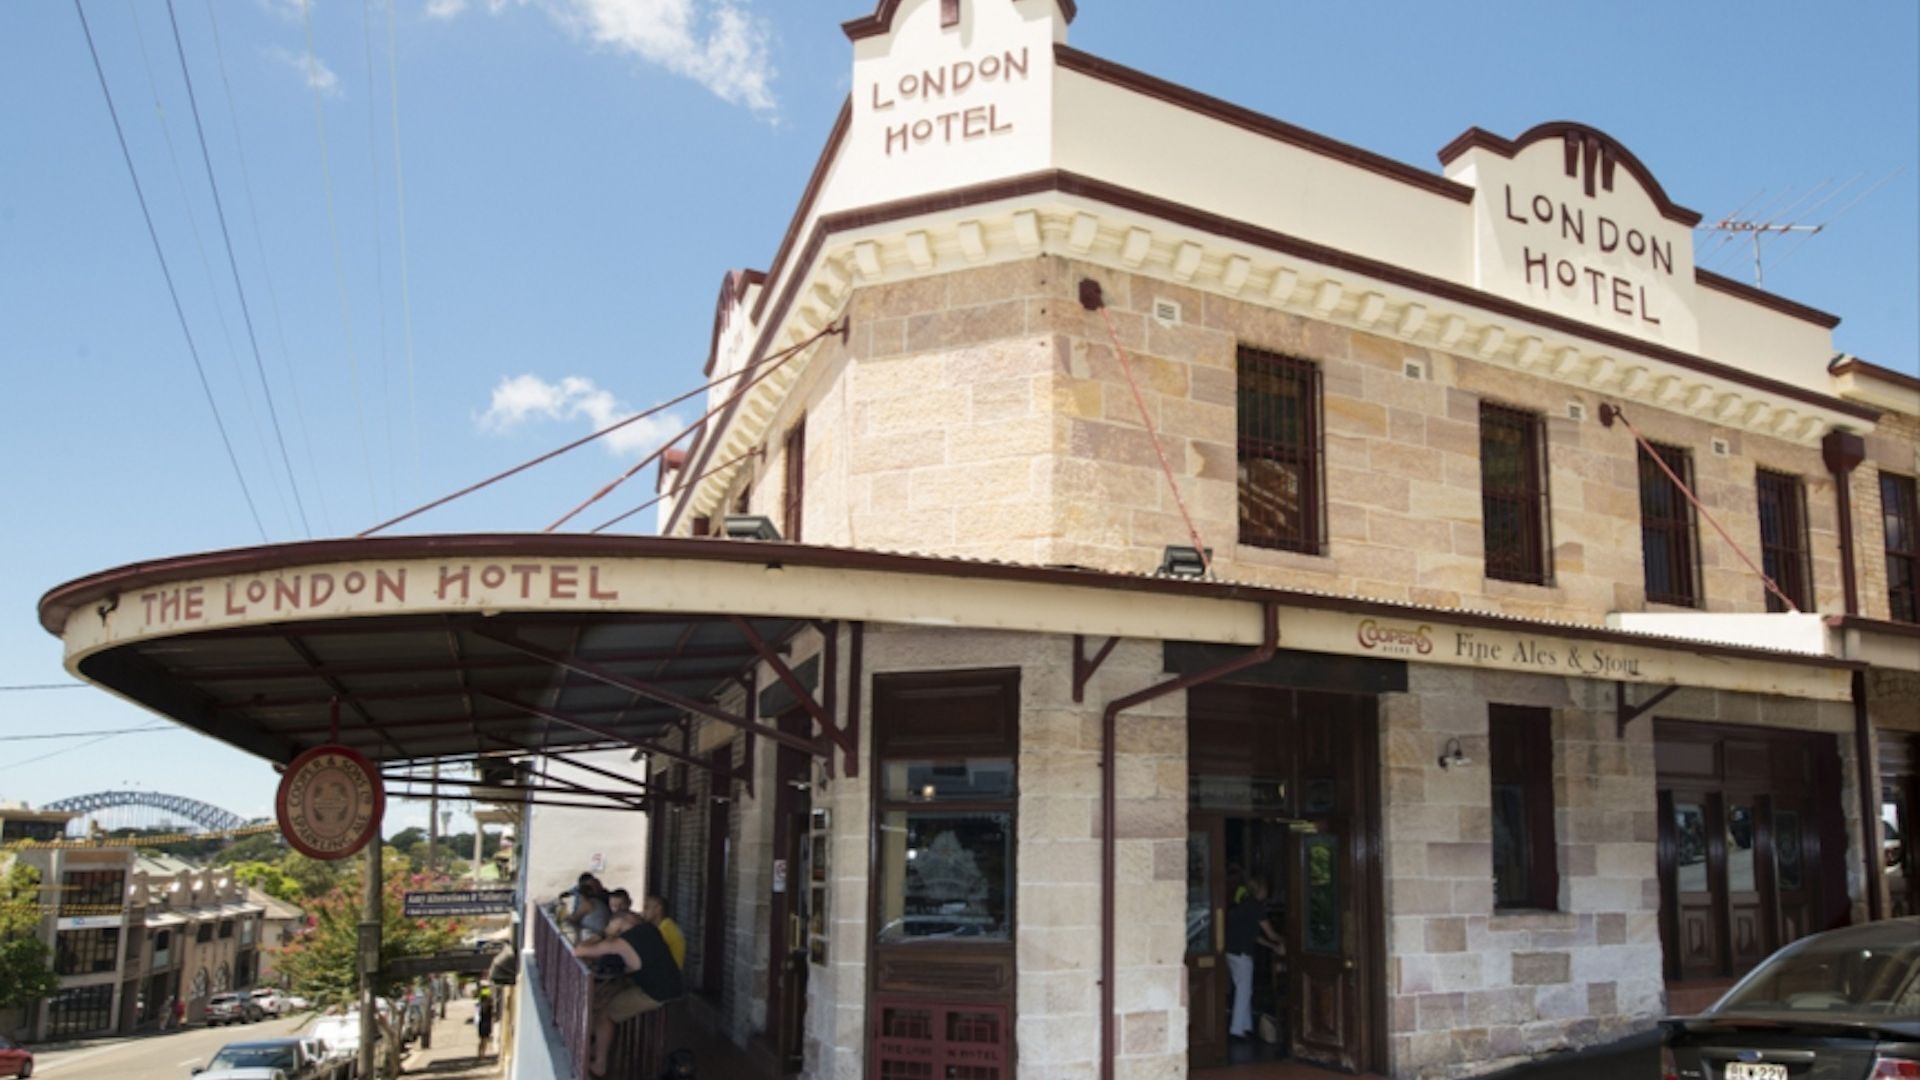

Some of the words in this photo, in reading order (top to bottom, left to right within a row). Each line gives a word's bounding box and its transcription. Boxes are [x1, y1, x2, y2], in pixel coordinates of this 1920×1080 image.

[872, 47, 1028, 110] LONDON
[886, 104, 1013, 155] HOTEL
[1506, 184, 1673, 275] LONDON
[1524, 246, 1660, 325] HOTEL
[140, 586, 204, 626] THE
[225, 568, 406, 617] LONDON
[438, 564, 619, 600] HOTEL
[1455, 632, 1501, 661] Fine
[1512, 640, 1557, 666] Ales
[1567, 646, 1583, 670] &
[1591, 649, 1641, 676] Stout
